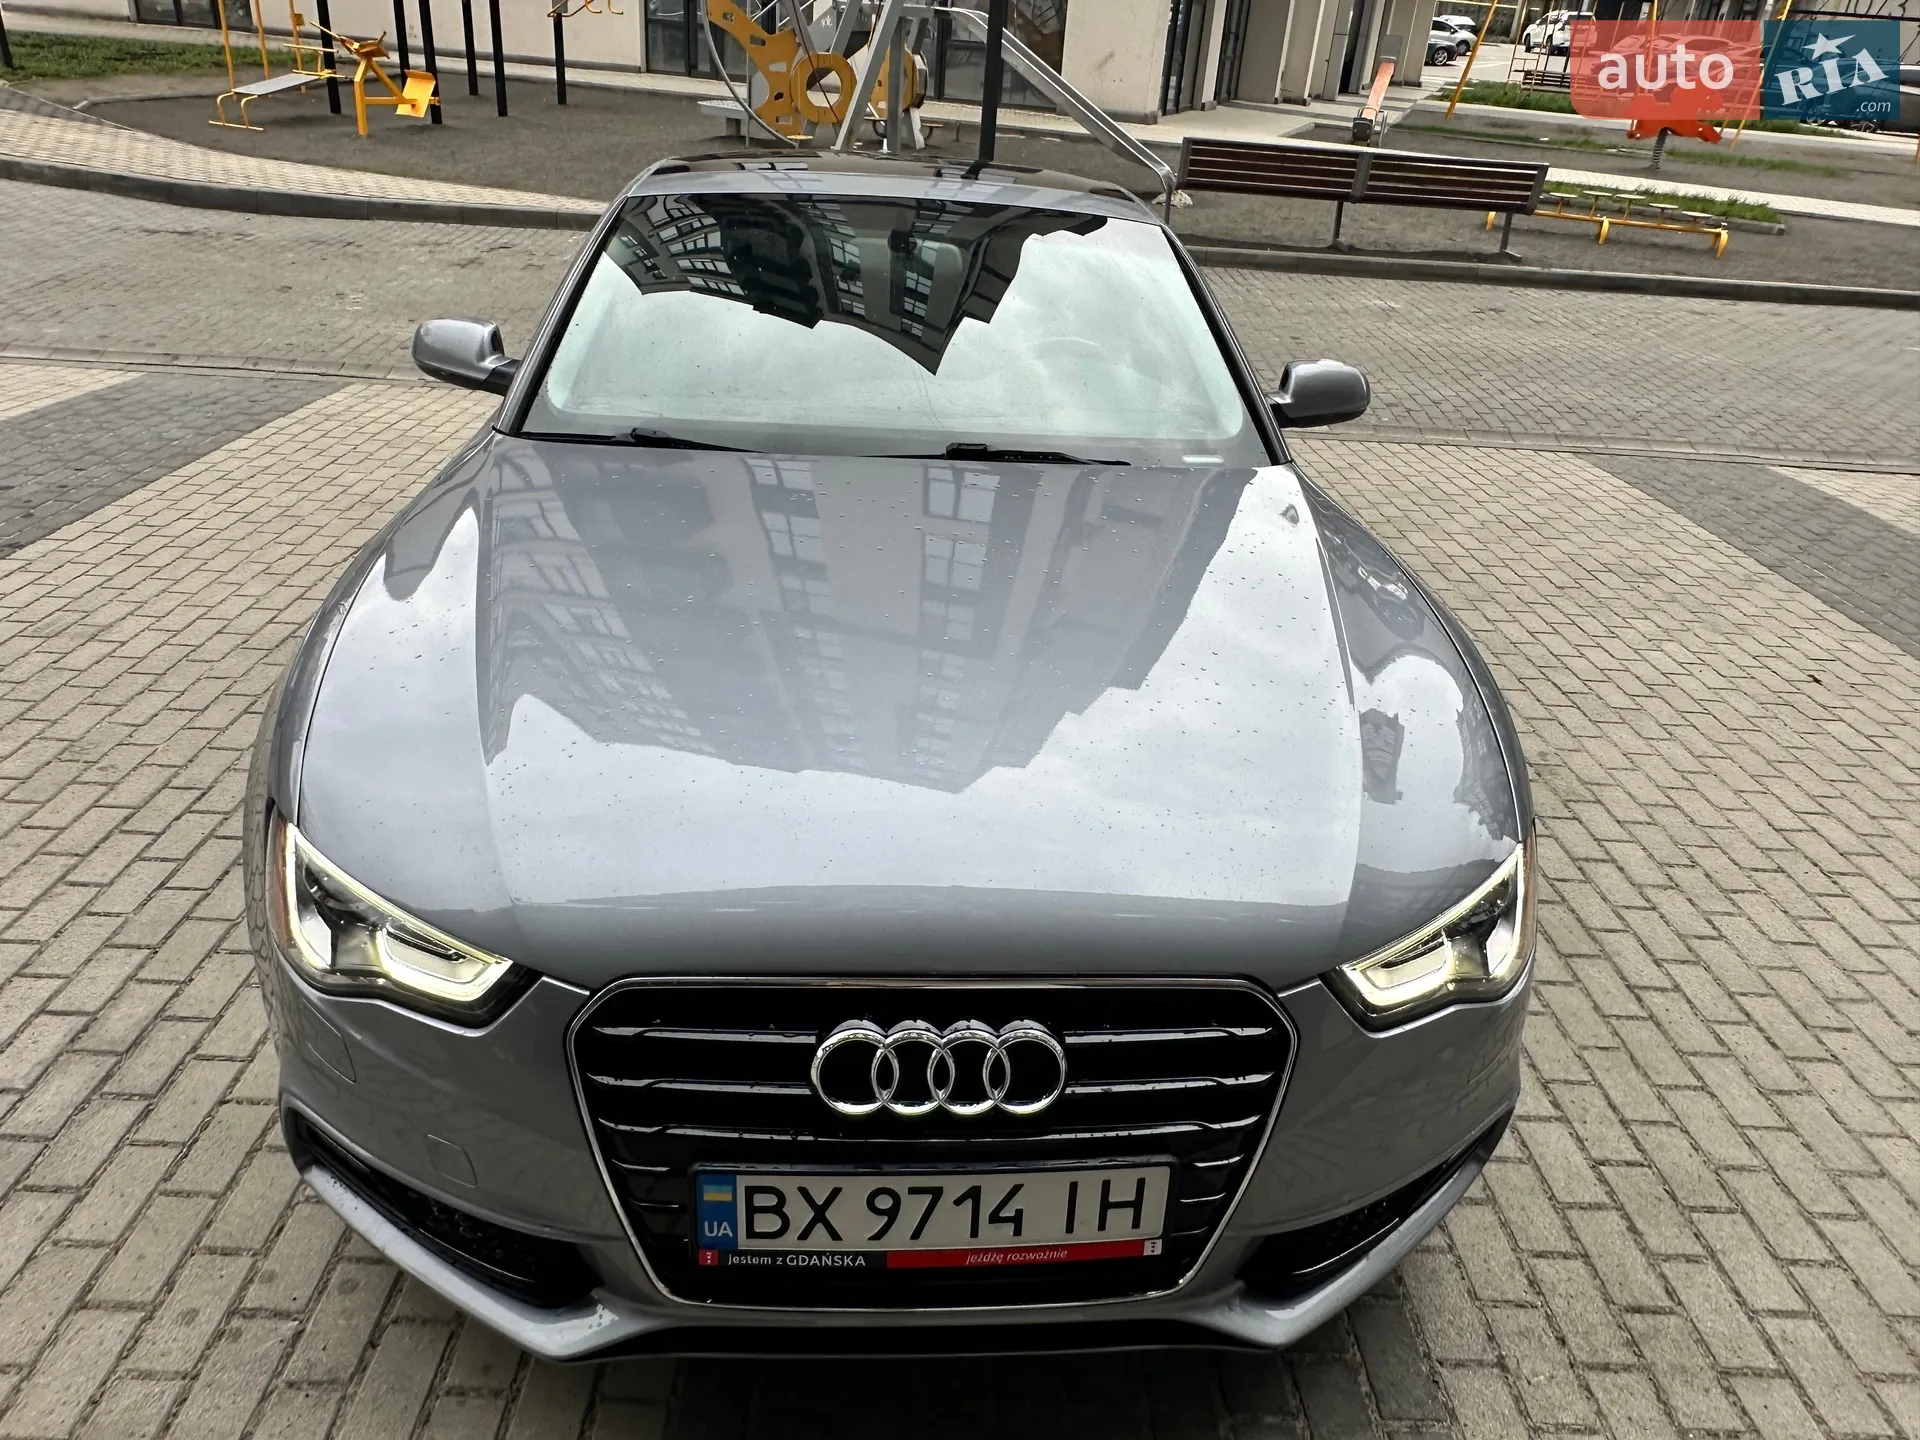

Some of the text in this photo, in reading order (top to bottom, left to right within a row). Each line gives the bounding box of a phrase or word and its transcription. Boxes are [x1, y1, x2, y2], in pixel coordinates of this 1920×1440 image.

[744, 1177, 1146, 1241] BX 9714 IH
[704, 1220, 733, 1237] UA
[776, 1257, 783, 1265] z
[786, 1252, 866, 1266] GDAŃSKA
